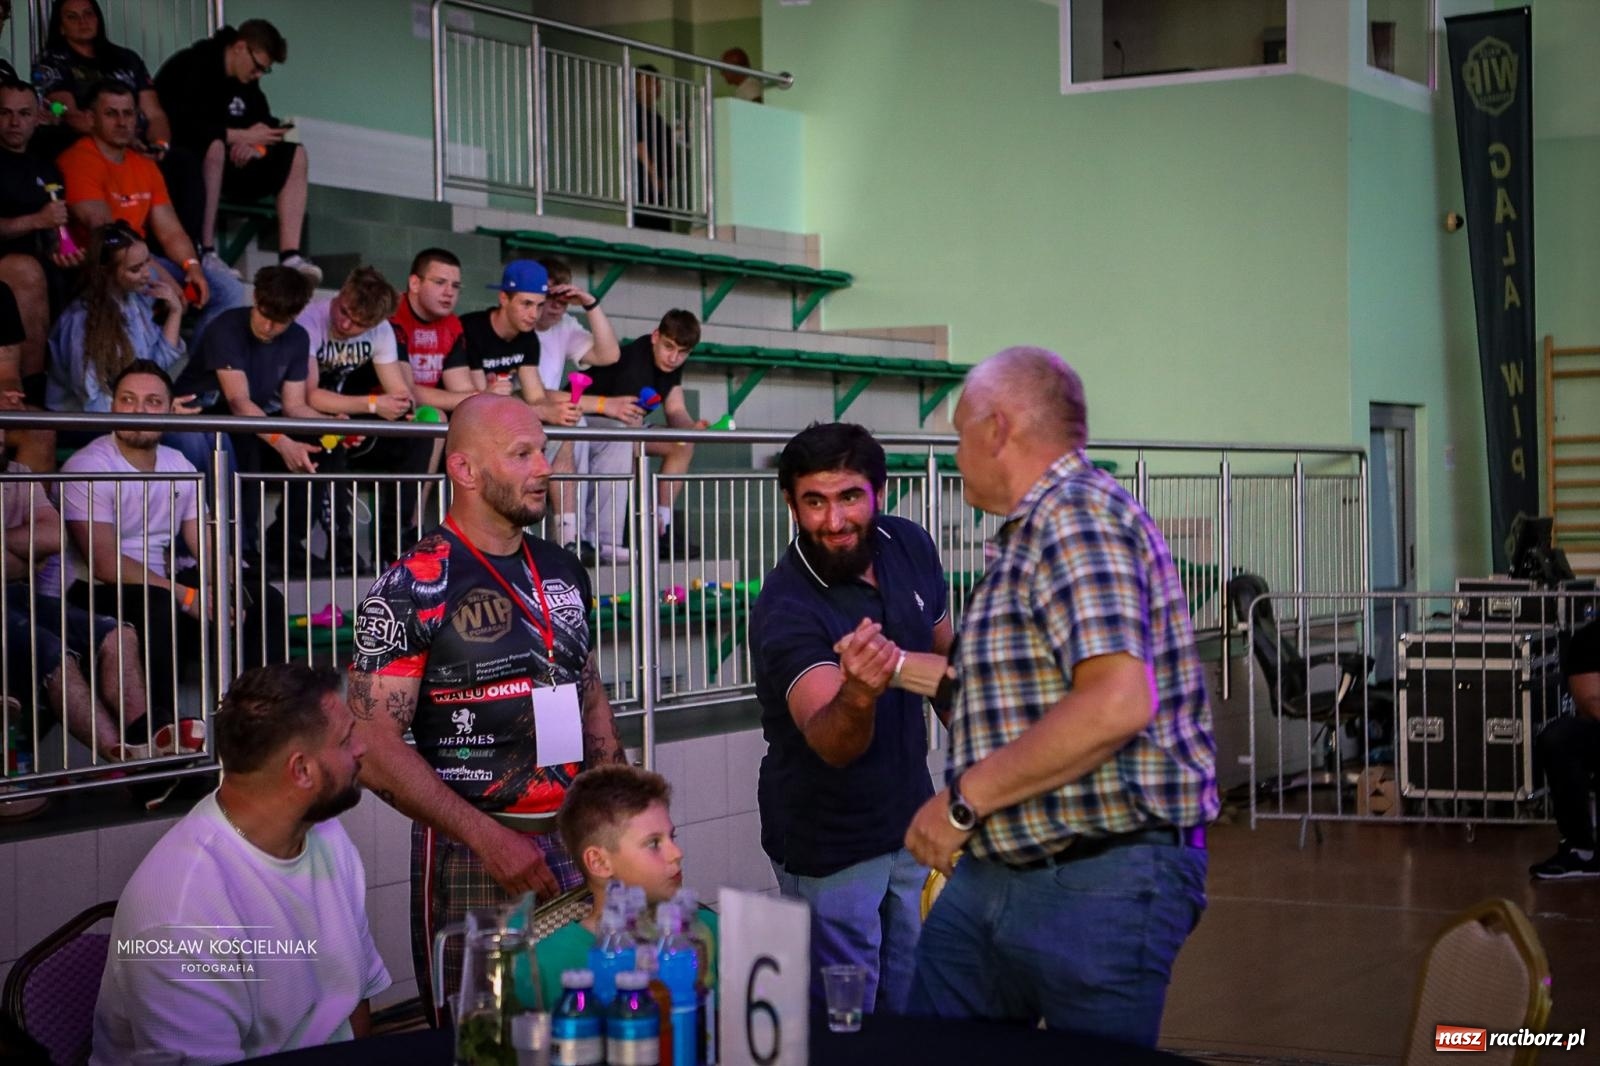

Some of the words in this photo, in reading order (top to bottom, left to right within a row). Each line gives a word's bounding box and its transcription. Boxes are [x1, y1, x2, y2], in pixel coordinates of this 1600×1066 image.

[452, 598, 512, 632] WIP
[355, 615, 407, 651] LESIA
[487, 681, 531, 697] OKNA
[437, 734, 495, 745] HERMES
[746, 955, 781, 1066] 6
